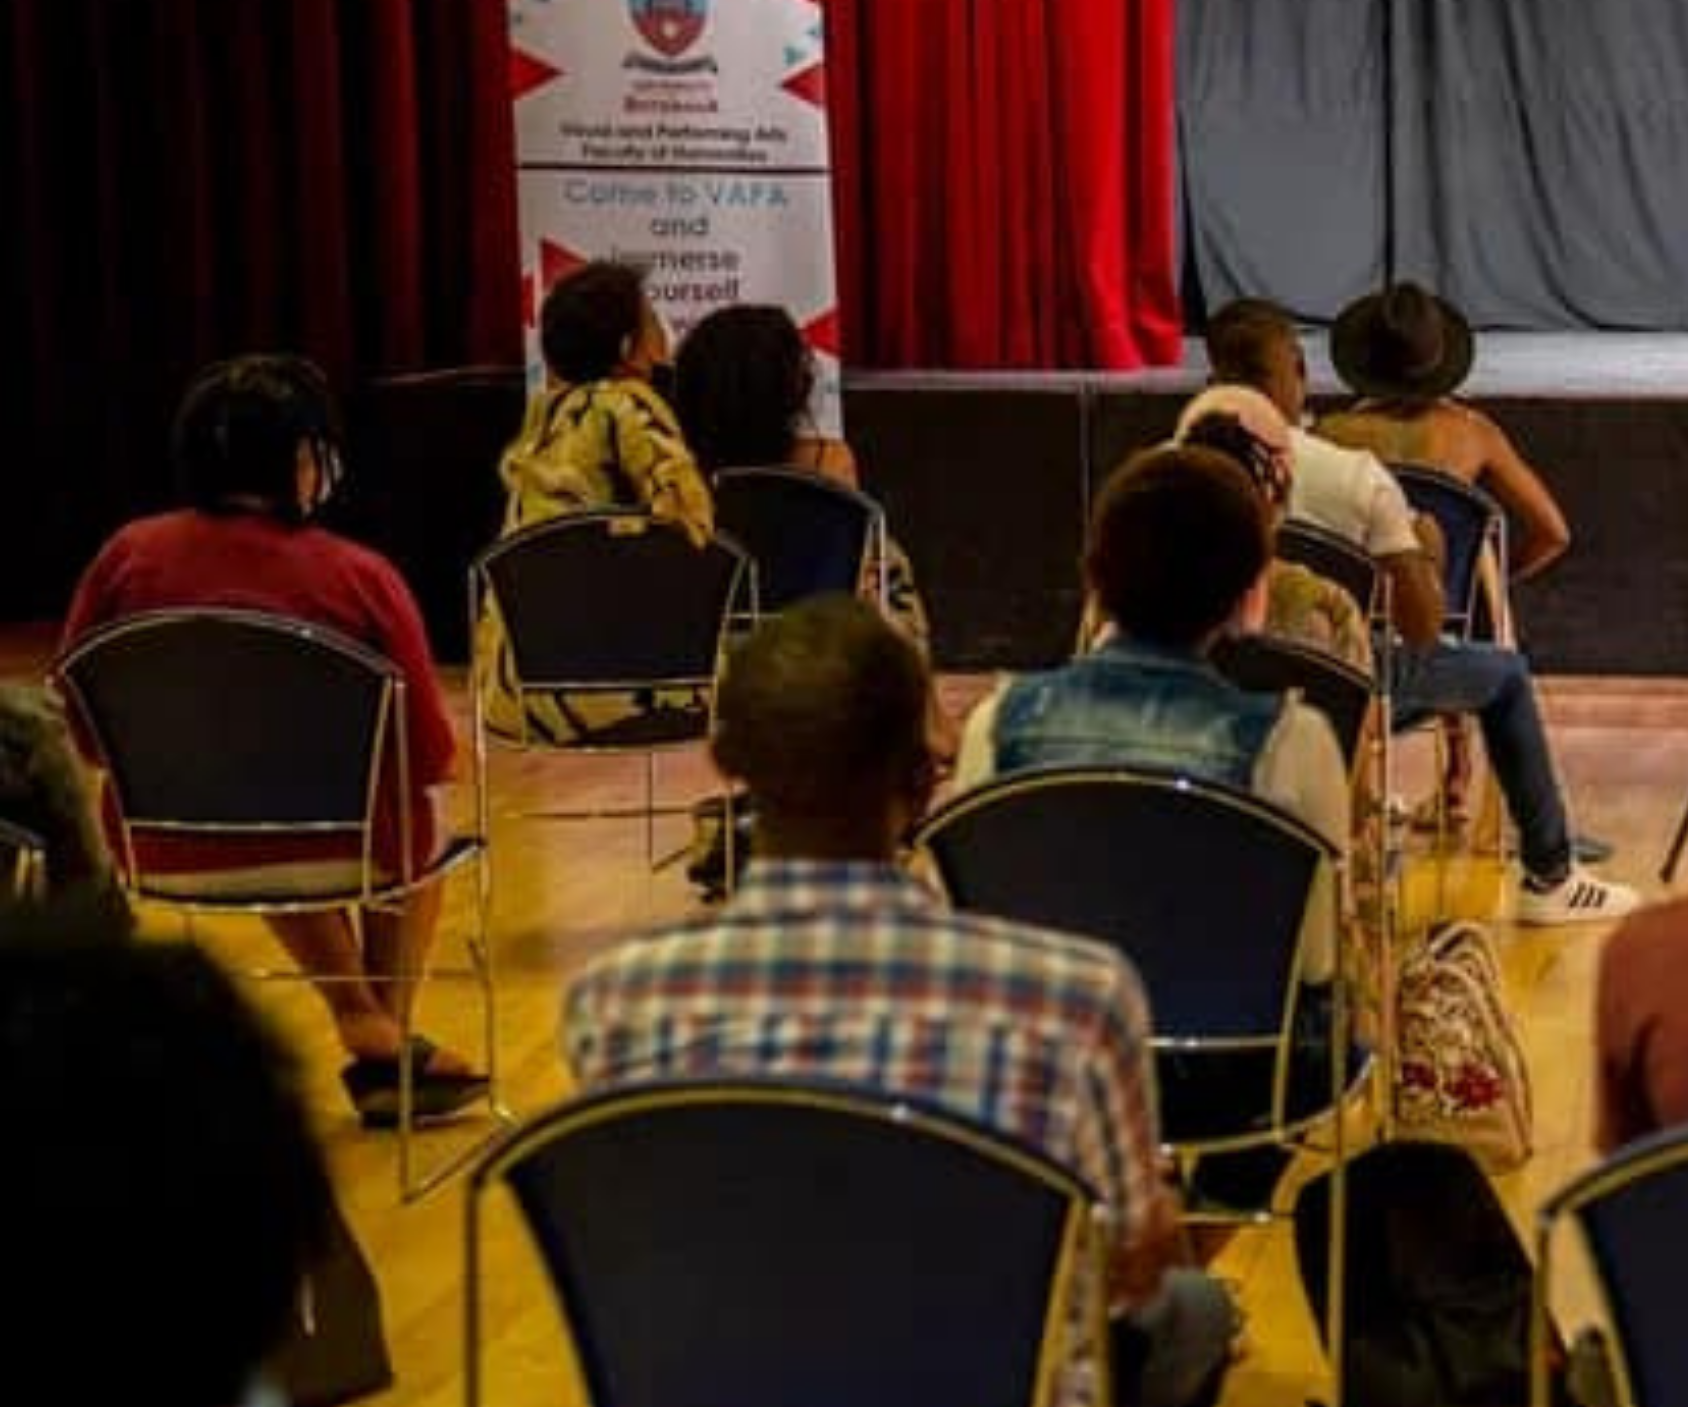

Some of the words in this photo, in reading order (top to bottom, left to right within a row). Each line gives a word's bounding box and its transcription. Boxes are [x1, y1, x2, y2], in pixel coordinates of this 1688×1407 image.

[616, 123, 653, 139] and
[656, 124, 751, 142] Performing
[754, 124, 788, 142] Arts
[581, 142, 646, 160] Faculty
[651, 144, 668, 160] of
[672, 144, 769, 163] Humanities
[563, 180, 656, 206] Come
[665, 180, 699, 204] to
[650, 216, 710, 237] and
[648, 277, 741, 300] ourself
